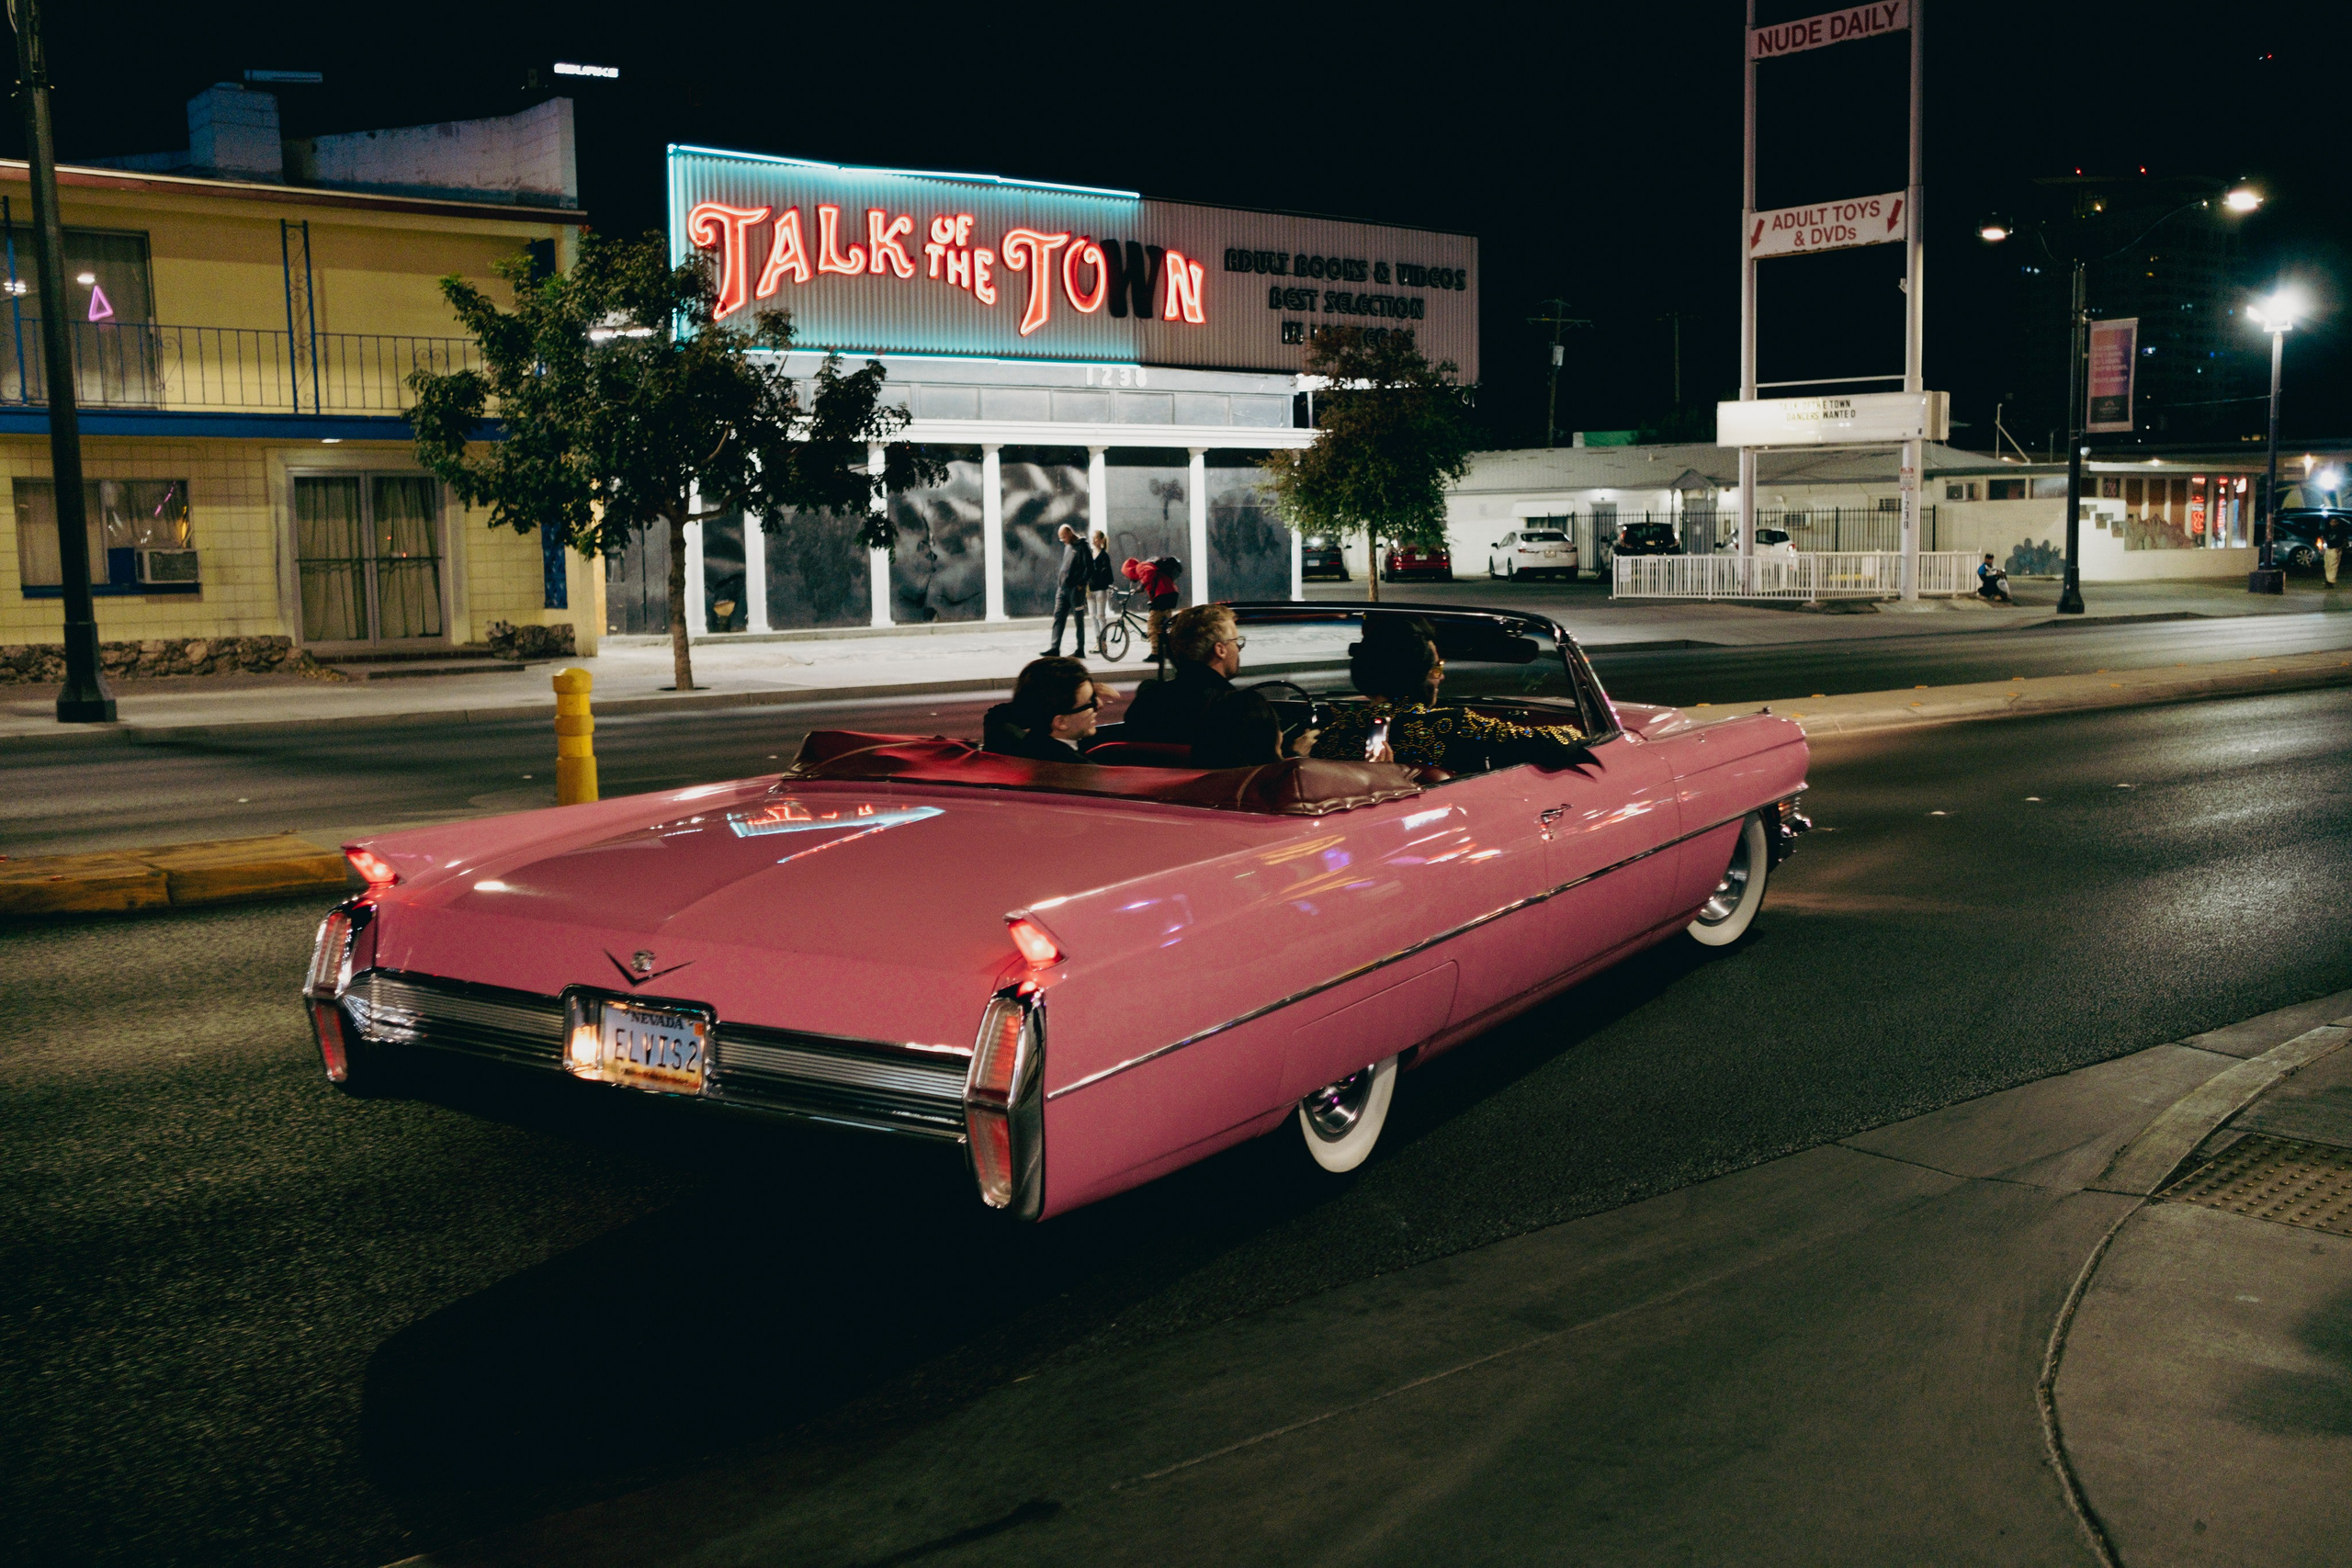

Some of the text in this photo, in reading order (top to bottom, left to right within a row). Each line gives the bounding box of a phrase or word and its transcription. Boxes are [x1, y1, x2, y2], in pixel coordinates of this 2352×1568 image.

[1758, 2, 1899, 55] NUDE DAILY
[1771, 199, 1881, 231] ADULT TOYS
[1793, 225, 1857, 247] & DVDs
[688, 201, 1205, 337] TALK OF THE TOWN
[1225, 248, 1466, 291] ADULT BOOKS & VIDEOS
[1270, 287, 1424, 320] BEST SELECTION
[1282, 321, 1304, 344] IN
[1086, 367, 1148, 388] 1238
[1830, 399, 1851, 409] TOWN
[631, 1011, 684, 1030] NEVADA
[615, 1028, 698, 1073] ELVIS2
